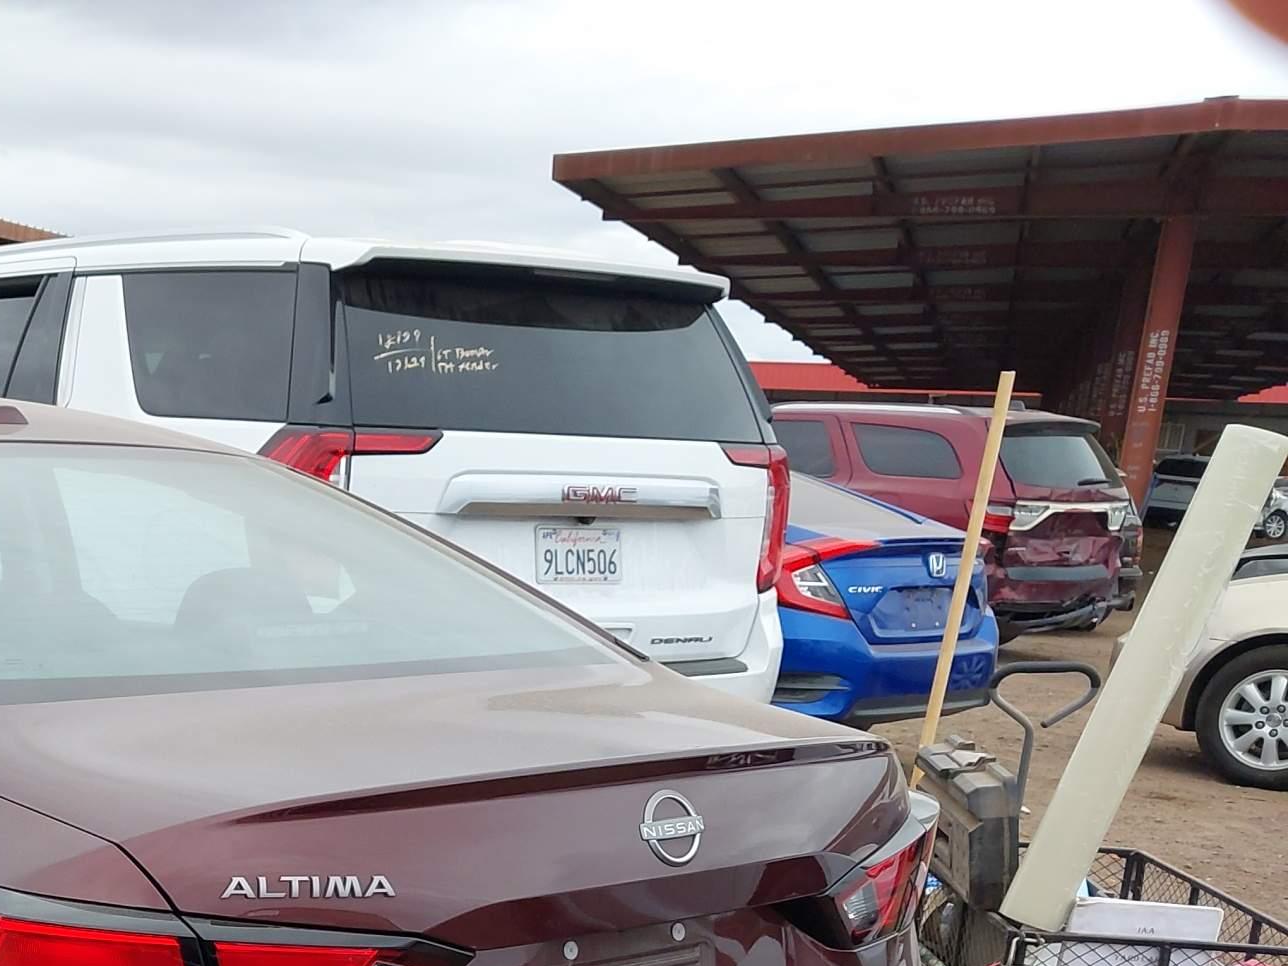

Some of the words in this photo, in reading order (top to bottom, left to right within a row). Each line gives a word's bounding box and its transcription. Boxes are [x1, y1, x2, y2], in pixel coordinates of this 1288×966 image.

[563, 486, 638, 503] GMC
[544, 549, 618, 576] 9LCN506
[651, 636, 713, 645] DENALI
[643, 819, 705, 838] NISSAN
[220, 875, 397, 899] ALTIMA
